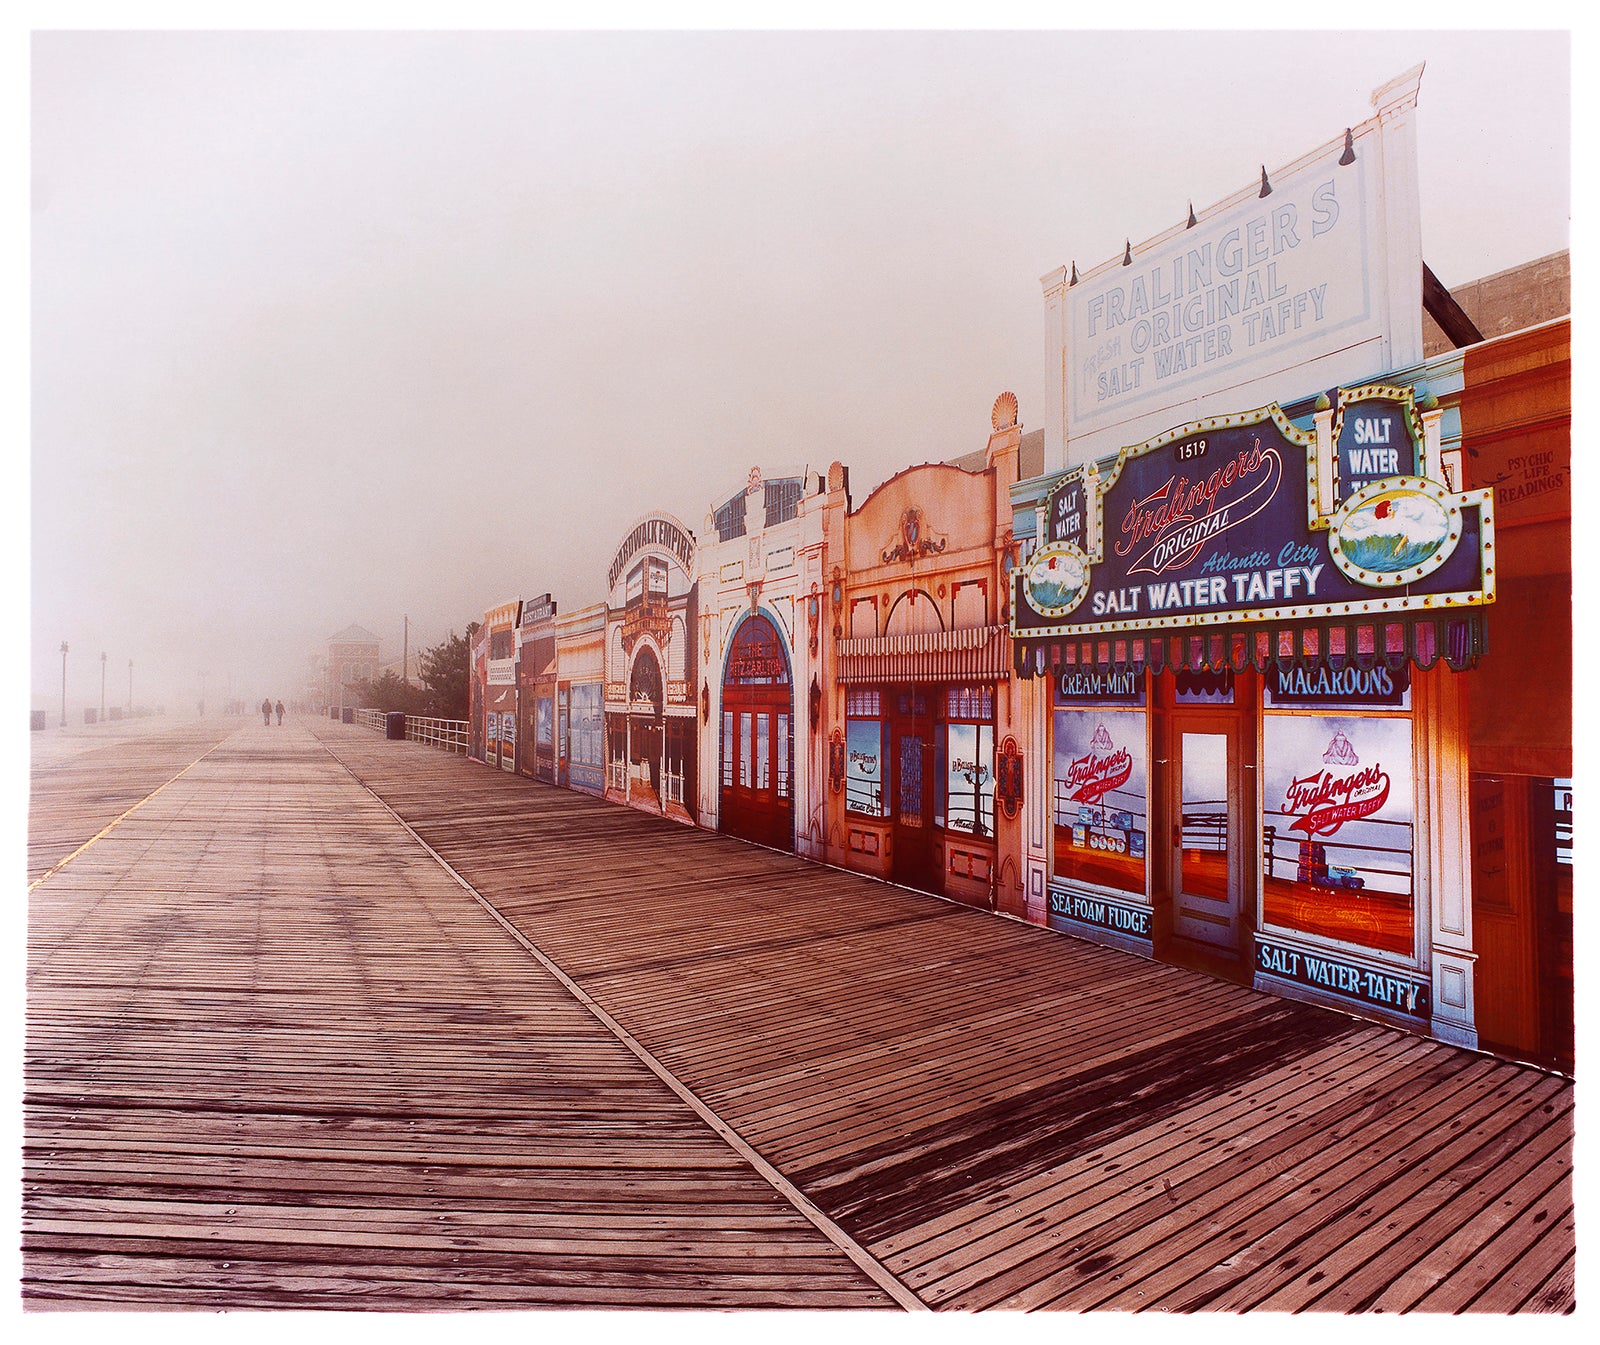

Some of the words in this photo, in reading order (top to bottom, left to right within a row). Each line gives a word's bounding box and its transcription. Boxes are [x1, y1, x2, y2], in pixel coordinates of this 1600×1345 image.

[1131, 262, 1287, 354] ORIGINAL
[1097, 357, 1144, 401] SALT
[1153, 324, 1232, 380] WATER
[1242, 283, 1327, 347] TAFFY
[1353, 418, 1391, 444] SALT
[1179, 440, 1207, 460] 1519
[1347, 448, 1400, 474] WATER
[1508, 450, 1553, 471] PSYCHIC
[1499, 473, 1564, 504] READINGS
[1524, 465, 1550, 480] LIFE
[1058, 490, 1078, 518] SALT
[1115, 438, 1262, 556] Fralingers
[1055, 511, 1080, 540] WATER
[1153, 509, 1229, 569] ORIGINAL
[609, 520, 658, 592] BOARDWALK
[1200, 551, 1271, 574] Atlantic
[1277, 540, 1320, 567] City
[1091, 585, 1142, 617] SALT
[1147, 575, 1228, 612] WATER
[1232, 563, 1325, 603] TAFFY
[1061, 671, 1136, 695] CREAM-MINT
[1278, 666, 1394, 696] MACAROONS
[1065, 746, 1127, 789] Fralingers
[1281, 763, 1381, 814] Fralingers
[1309, 812, 1331, 829] SALT
[1331, 806, 1357, 821] WATER
[1358, 798, 1382, 815] TAFFY
[1052, 892, 1105, 925] SEA-FOAM
[1108, 904, 1148, 934] FUDGE
[1261, 944, 1301, 977] SALT
[1303, 955, 1420, 1011] WATER-TAFFY
